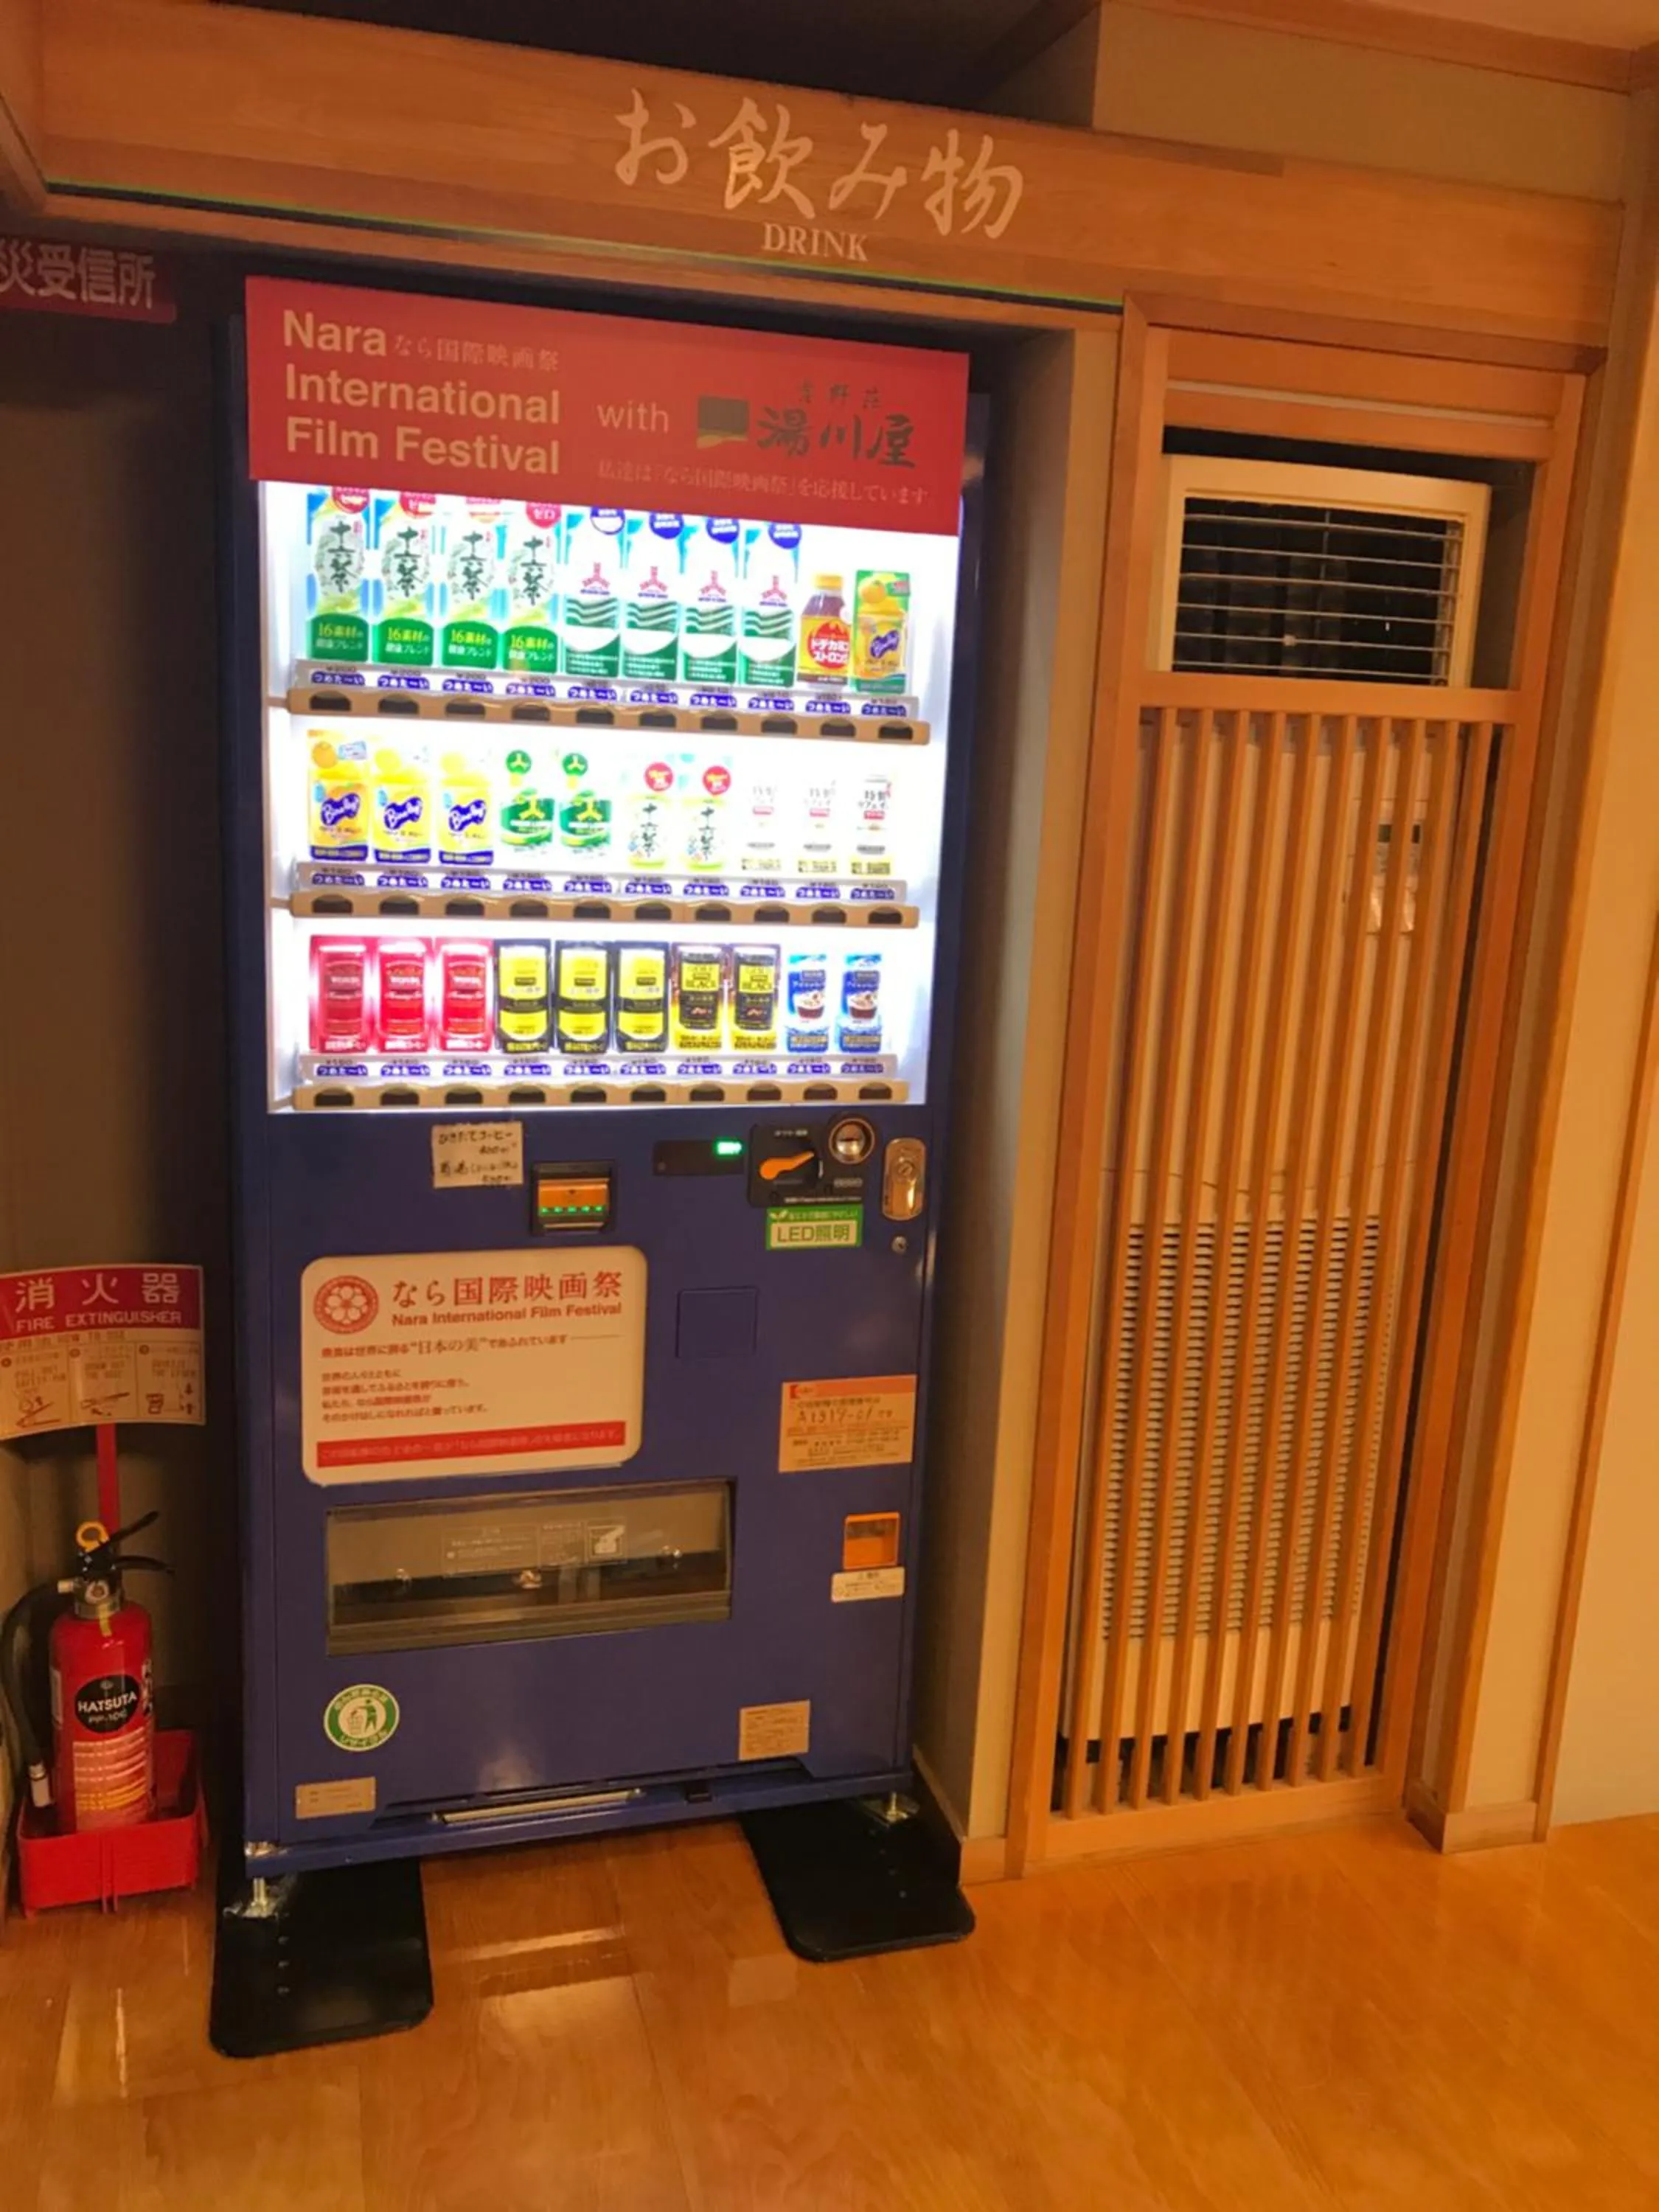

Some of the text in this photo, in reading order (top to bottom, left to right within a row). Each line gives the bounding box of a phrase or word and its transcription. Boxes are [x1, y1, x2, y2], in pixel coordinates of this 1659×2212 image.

[614, 88, 1024, 240] お飲み物
[763, 223, 869, 261] DRINK
[283, 310, 386, 357] Nara
[392, 334, 560, 372] なら国際映画祭
[285, 363, 560, 425] International
[596, 400, 669, 433] with
[286, 417, 560, 475] Film Festival
[776, 1224, 850, 1243] LED照明
[15, 1272, 181, 1313] 消火器
[392, 1270, 623, 1308] なら国際映画祭
[16, 1310, 182, 1332] FIRE EXTINGUISHER
[392, 1302, 622, 1327] Nara International Film Festival
[77, 1690, 138, 1714] HATSUTA
